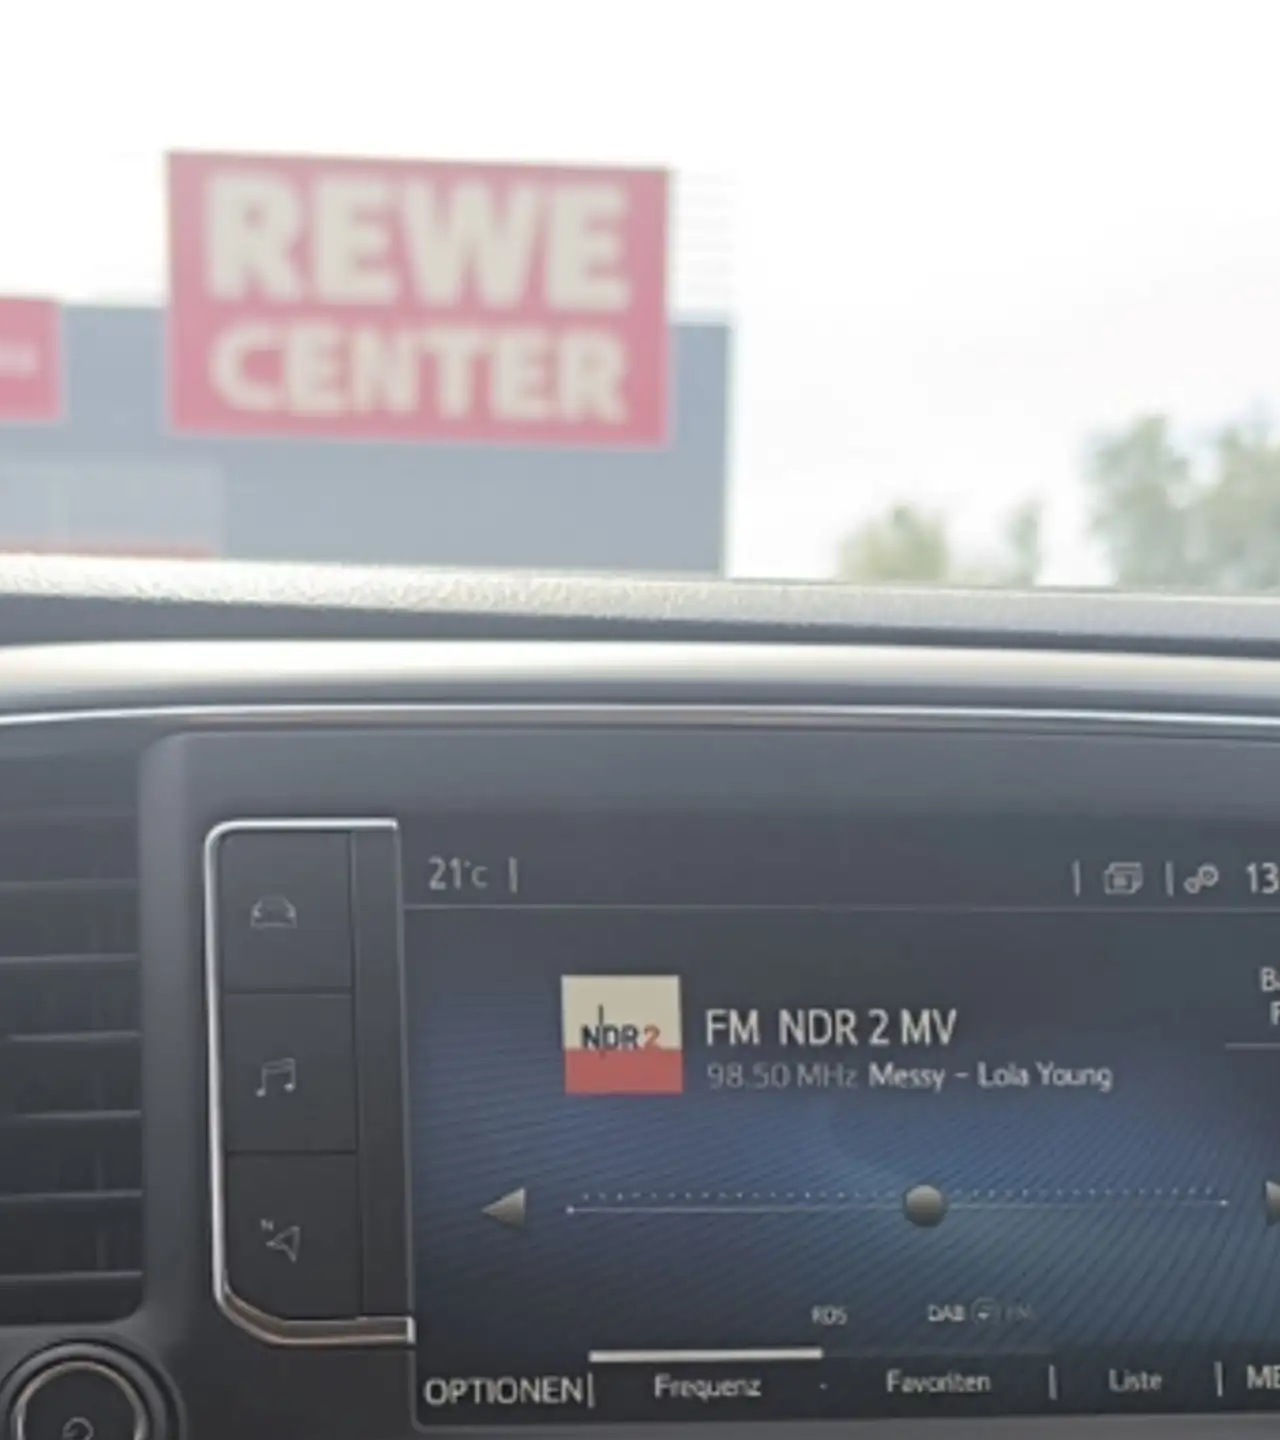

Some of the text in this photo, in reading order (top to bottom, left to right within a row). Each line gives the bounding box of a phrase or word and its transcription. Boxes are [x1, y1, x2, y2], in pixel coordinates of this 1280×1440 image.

[205, 171, 632, 314] REWE
[207, 320, 630, 427] CENTER
[581, 1024, 638, 1051] NDR
[706, 1009, 957, 1046] FM NDR 2 MV
[706, 1064, 790, 1090] 98.50
[797, 1065, 858, 1089] MHz
[869, 1064, 945, 1091] Messy
[977, 1062, 1030, 1087] Lola
[1036, 1062, 1114, 1092] Young
[425, 1378, 582, 1406] OPTIONEN
[654, 1373, 762, 1400] Frequenz
[887, 1368, 991, 1394] Favoriten
[1109, 1368, 1162, 1392] Liste
